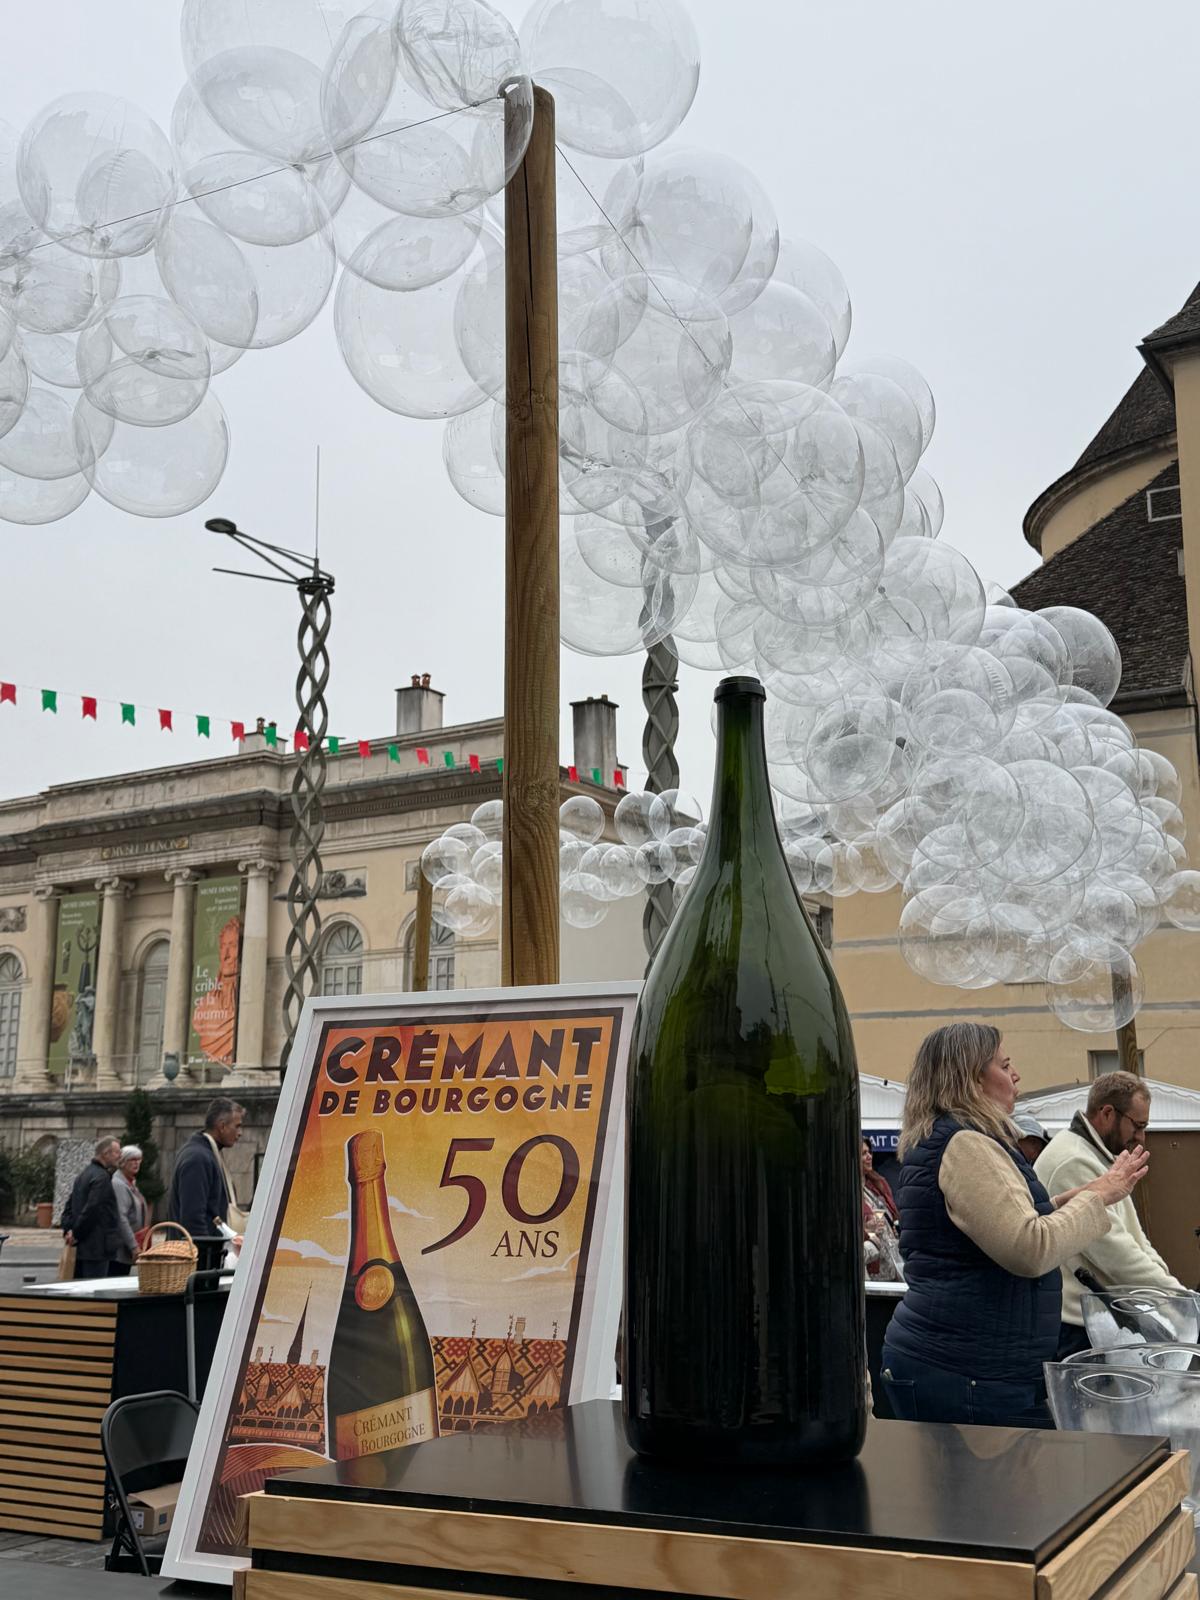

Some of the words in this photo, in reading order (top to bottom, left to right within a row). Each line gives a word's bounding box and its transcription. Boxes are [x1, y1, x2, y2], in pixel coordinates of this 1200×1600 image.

[194, 978, 224, 993] crible
[196, 965, 209, 978] Le
[193, 1007, 228, 1020] fourmi
[194, 996, 205, 1006] et
[326, 1027, 603, 1086] CRÉMANT
[318, 1090, 360, 1117] DE
[372, 1083, 593, 1116] BOURGOGNE
[421, 1134, 580, 1255] 50
[491, 1230, 560, 1258] ANS
[353, 1406, 413, 1437] CRÉMANT
[361, 1423, 426, 1454] BOURGOGNE
